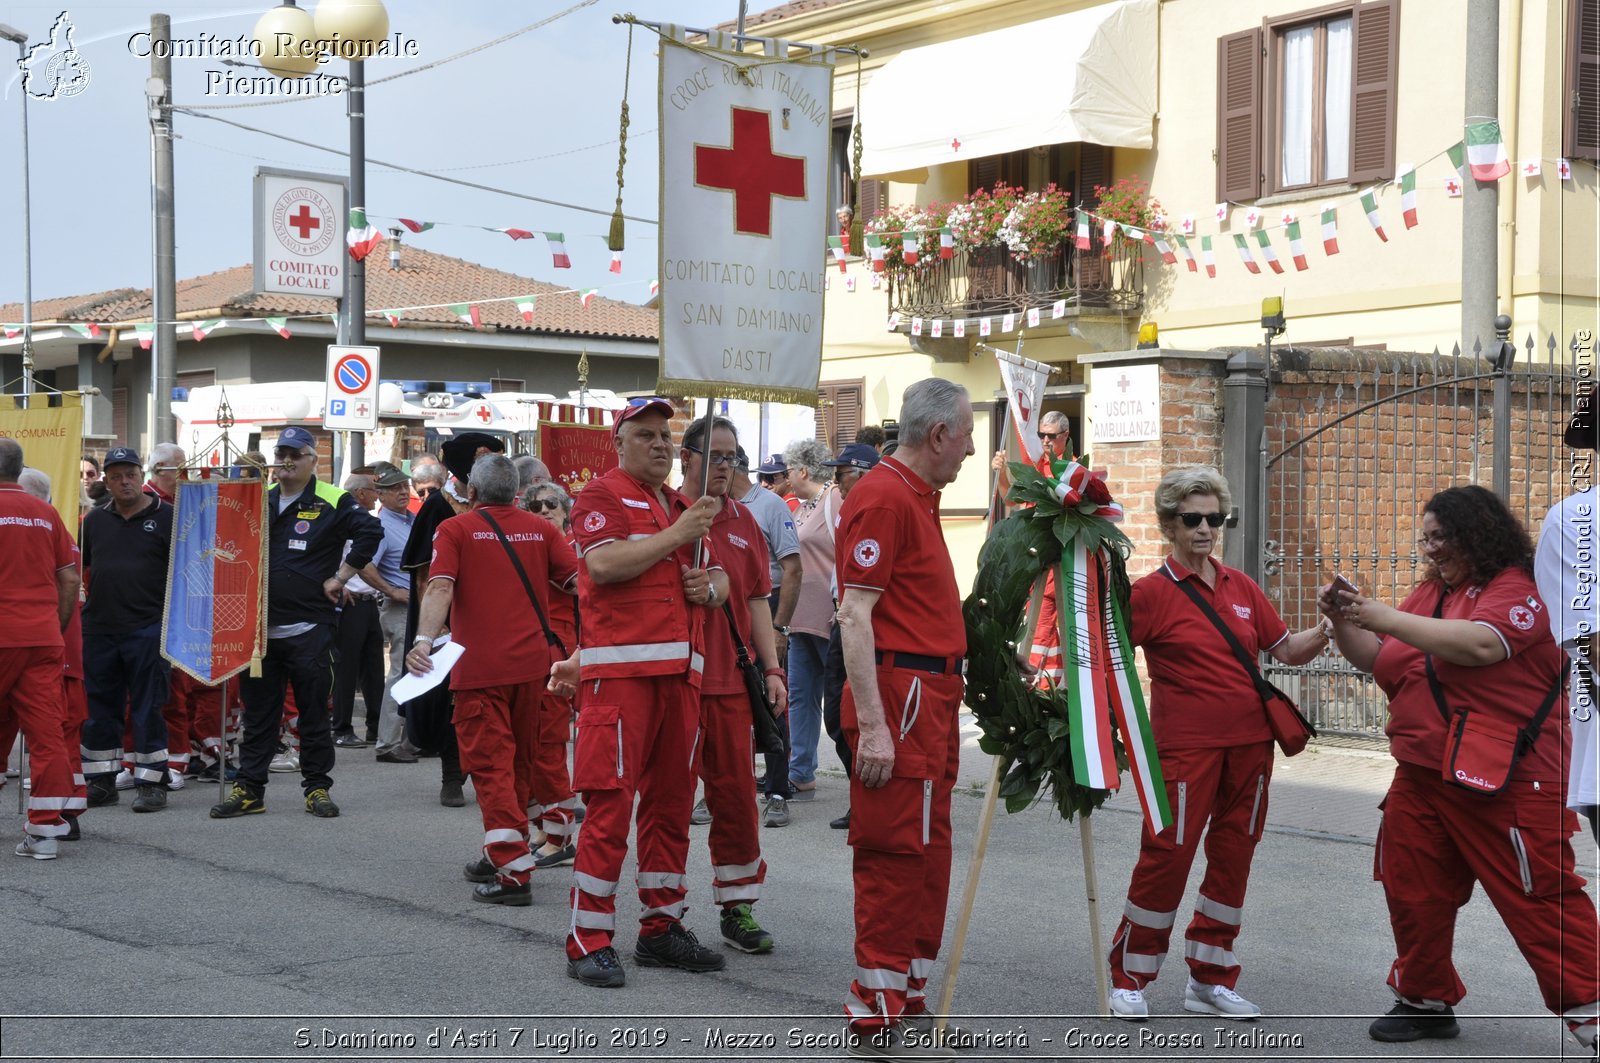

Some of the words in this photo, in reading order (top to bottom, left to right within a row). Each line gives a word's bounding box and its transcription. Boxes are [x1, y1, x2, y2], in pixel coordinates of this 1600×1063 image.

[670, 66, 715, 111] CROCE
[771, 70, 826, 128] ITALIANA
[291, 189, 322, 206] GINEVRA
[270, 260, 339, 277] COMITATO
[664, 259, 755, 287] COMITATO
[768, 268, 825, 295] LOCALE
[278, 275, 331, 290] LOCALE
[683, 302, 723, 326] SAN
[737, 306, 812, 334] DAMIANO
[722, 347, 772, 372] D'ASTI
[333, 401, 343, 414] P
[1106, 400, 1143, 417] USCITA
[15, 427, 66, 438] COMUNALE
[1094, 421, 1157, 438] AMBULANZA
[244, 509, 262, 536] CIVILE
[1070, 626, 1100, 671] MEZZO
